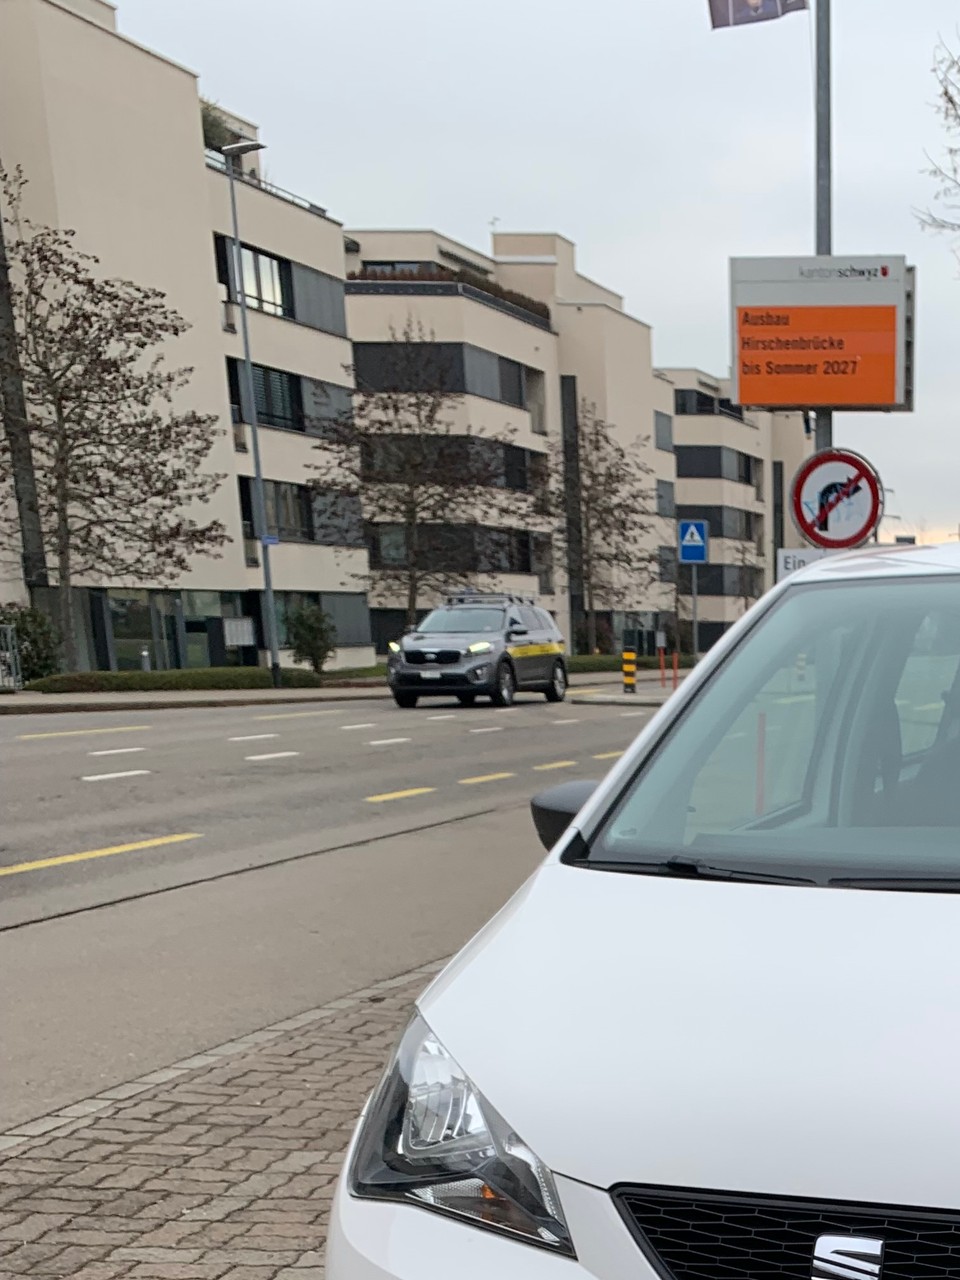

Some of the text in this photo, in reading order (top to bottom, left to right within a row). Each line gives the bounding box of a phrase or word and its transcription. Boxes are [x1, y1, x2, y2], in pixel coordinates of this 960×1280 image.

[742, 312, 789, 326] Ausbau
[741, 336, 844, 350] Hirschenbrücke
[742, 360, 857, 375] bis Sommer 2027
